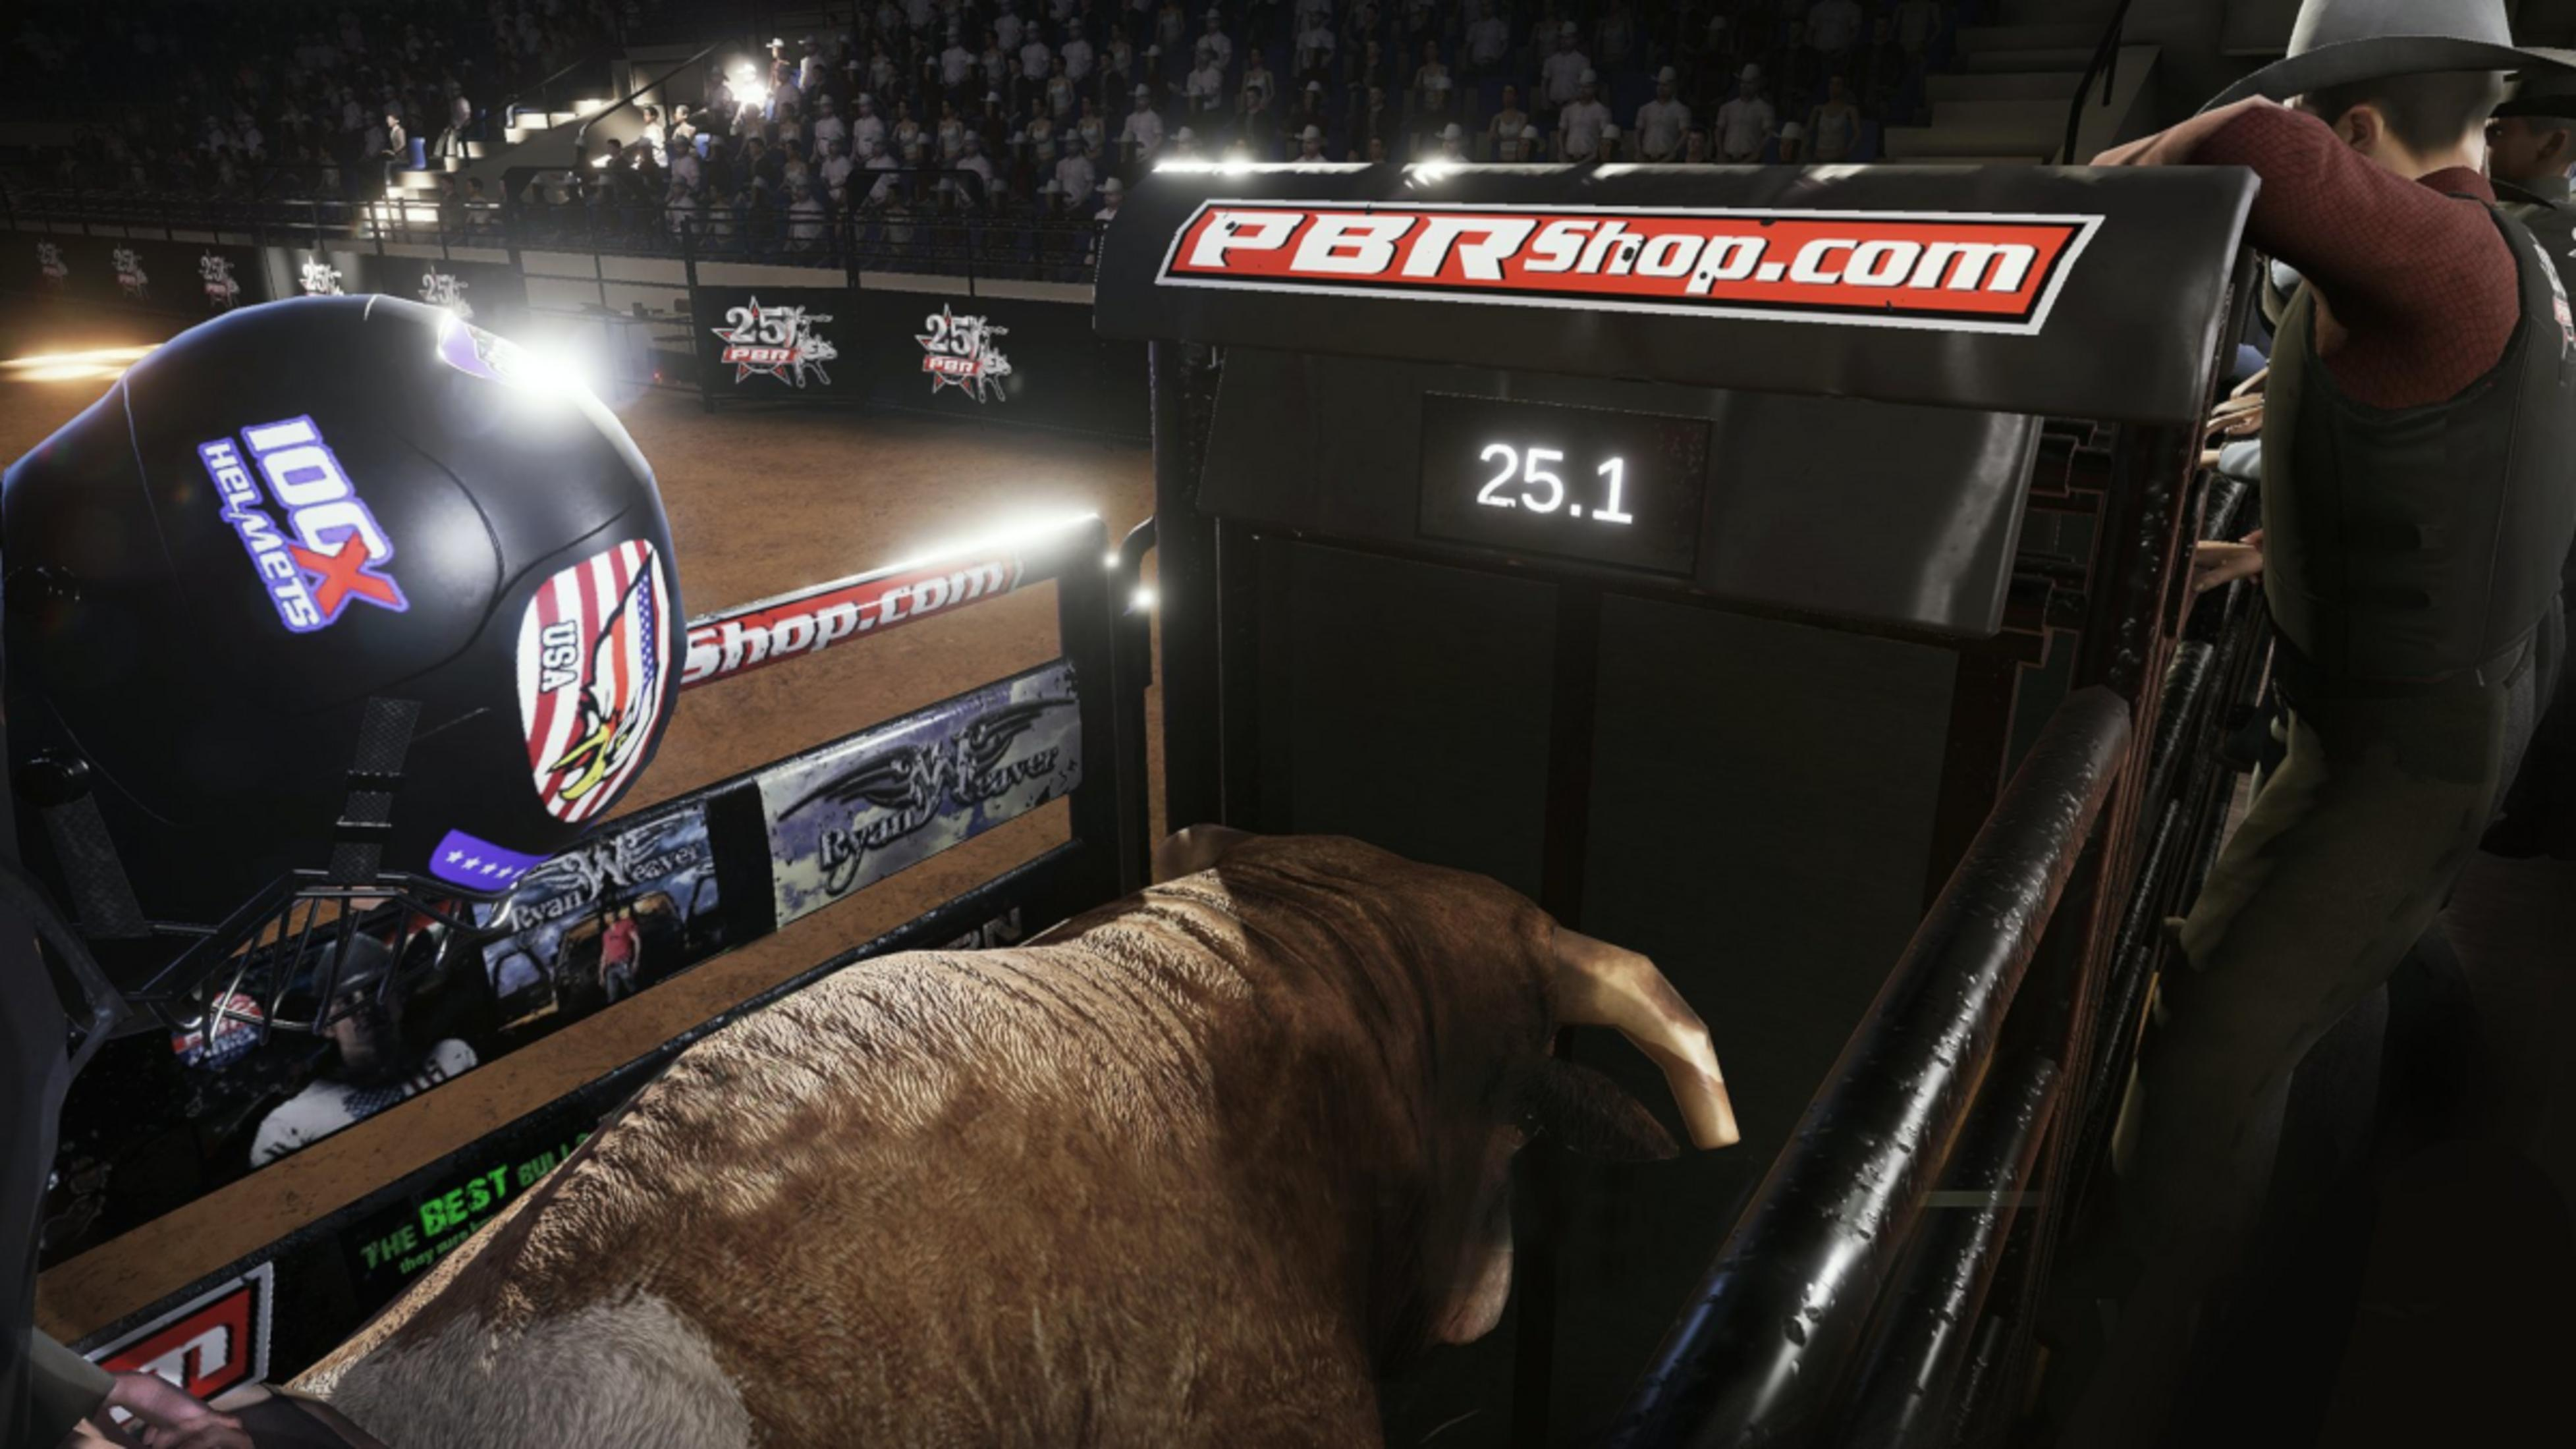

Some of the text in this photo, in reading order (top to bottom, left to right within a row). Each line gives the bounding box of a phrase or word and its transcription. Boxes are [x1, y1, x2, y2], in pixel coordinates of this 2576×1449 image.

[1188, 211, 2037, 295] PBRShop.com
[725, 306, 788, 344] 25
[925, 314, 973, 354] 25
[730, 348, 790, 362] PBR
[929, 358, 973, 373] PBR
[1476, 443, 1633, 525] 25.1
[539, 620, 578, 694] USA
[360, 1224, 418, 1270] THE
[419, 1163, 508, 1237] BEST
